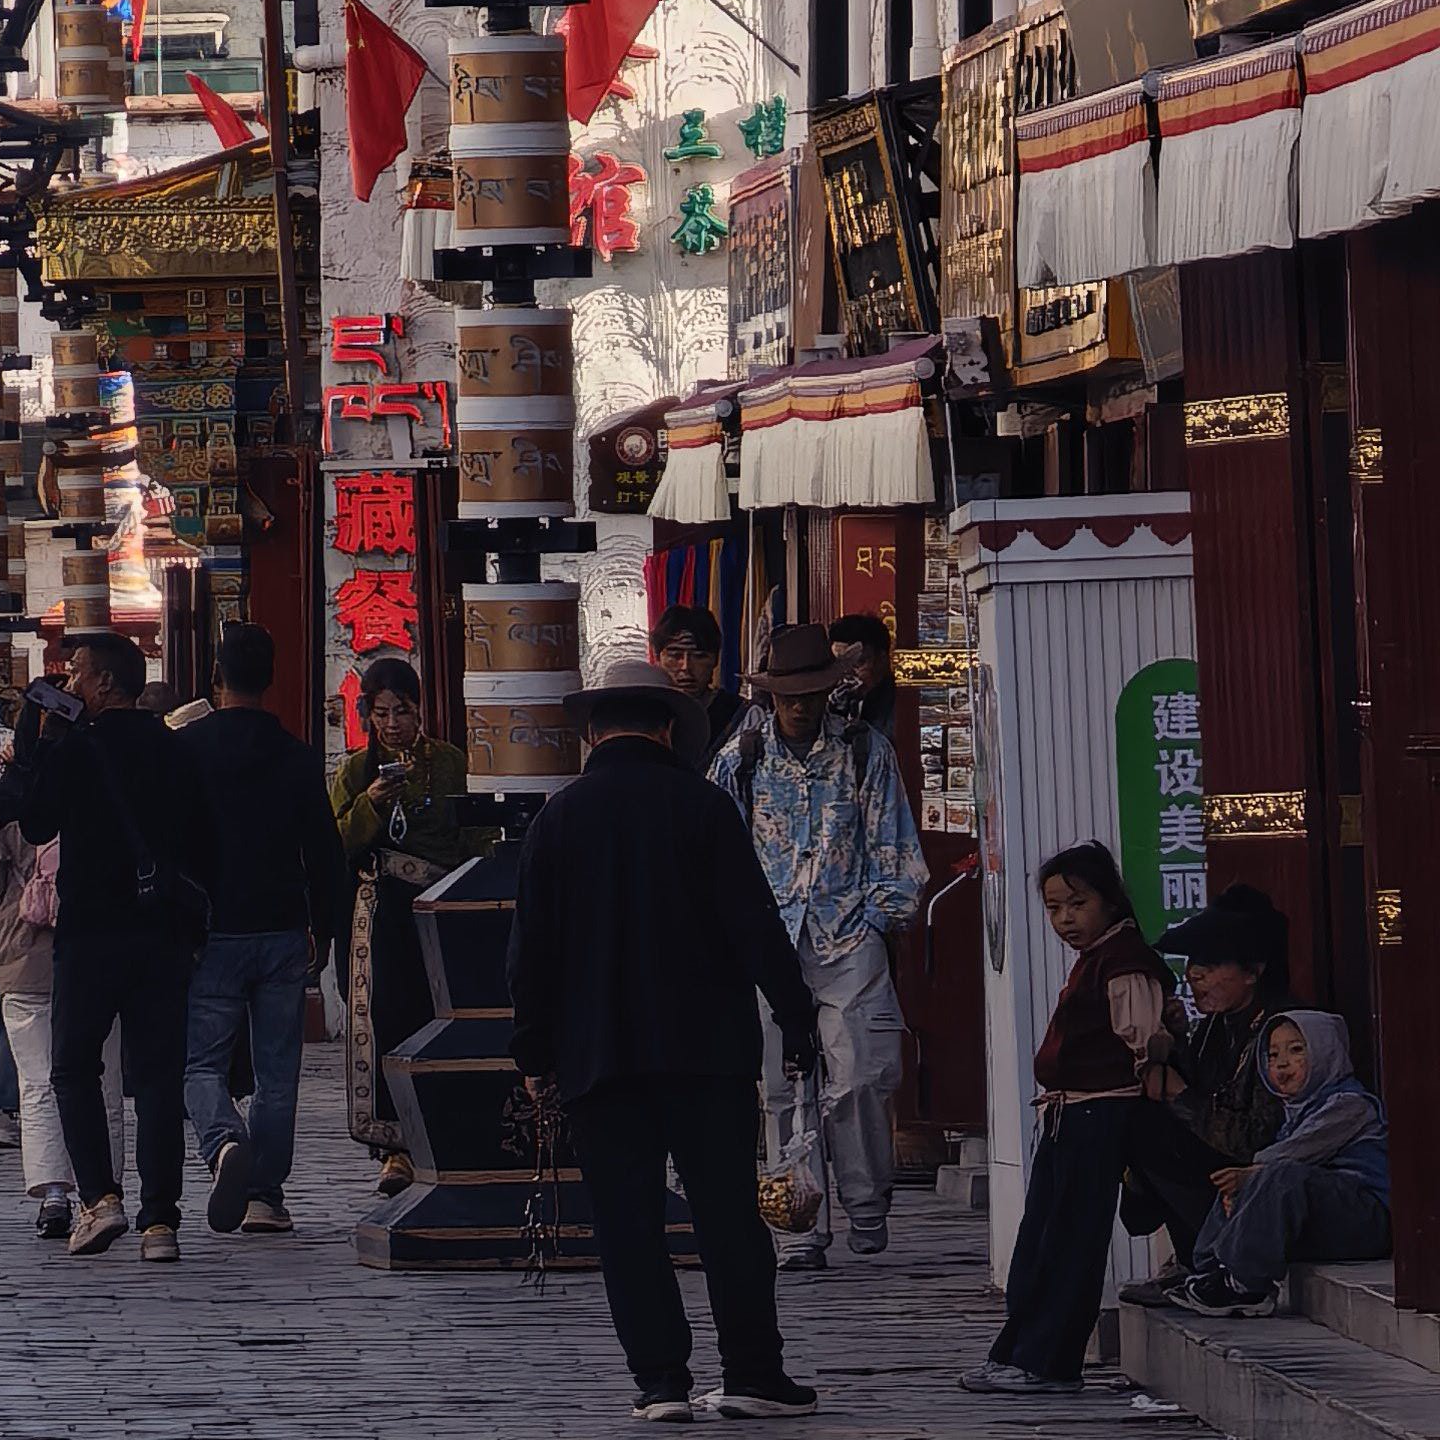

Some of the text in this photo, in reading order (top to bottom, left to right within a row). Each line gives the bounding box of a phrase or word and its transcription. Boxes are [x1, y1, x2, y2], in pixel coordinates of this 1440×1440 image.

[333, 471, 419, 750] 藏餐
[1151, 691, 1208, 1028] 建设美丽
